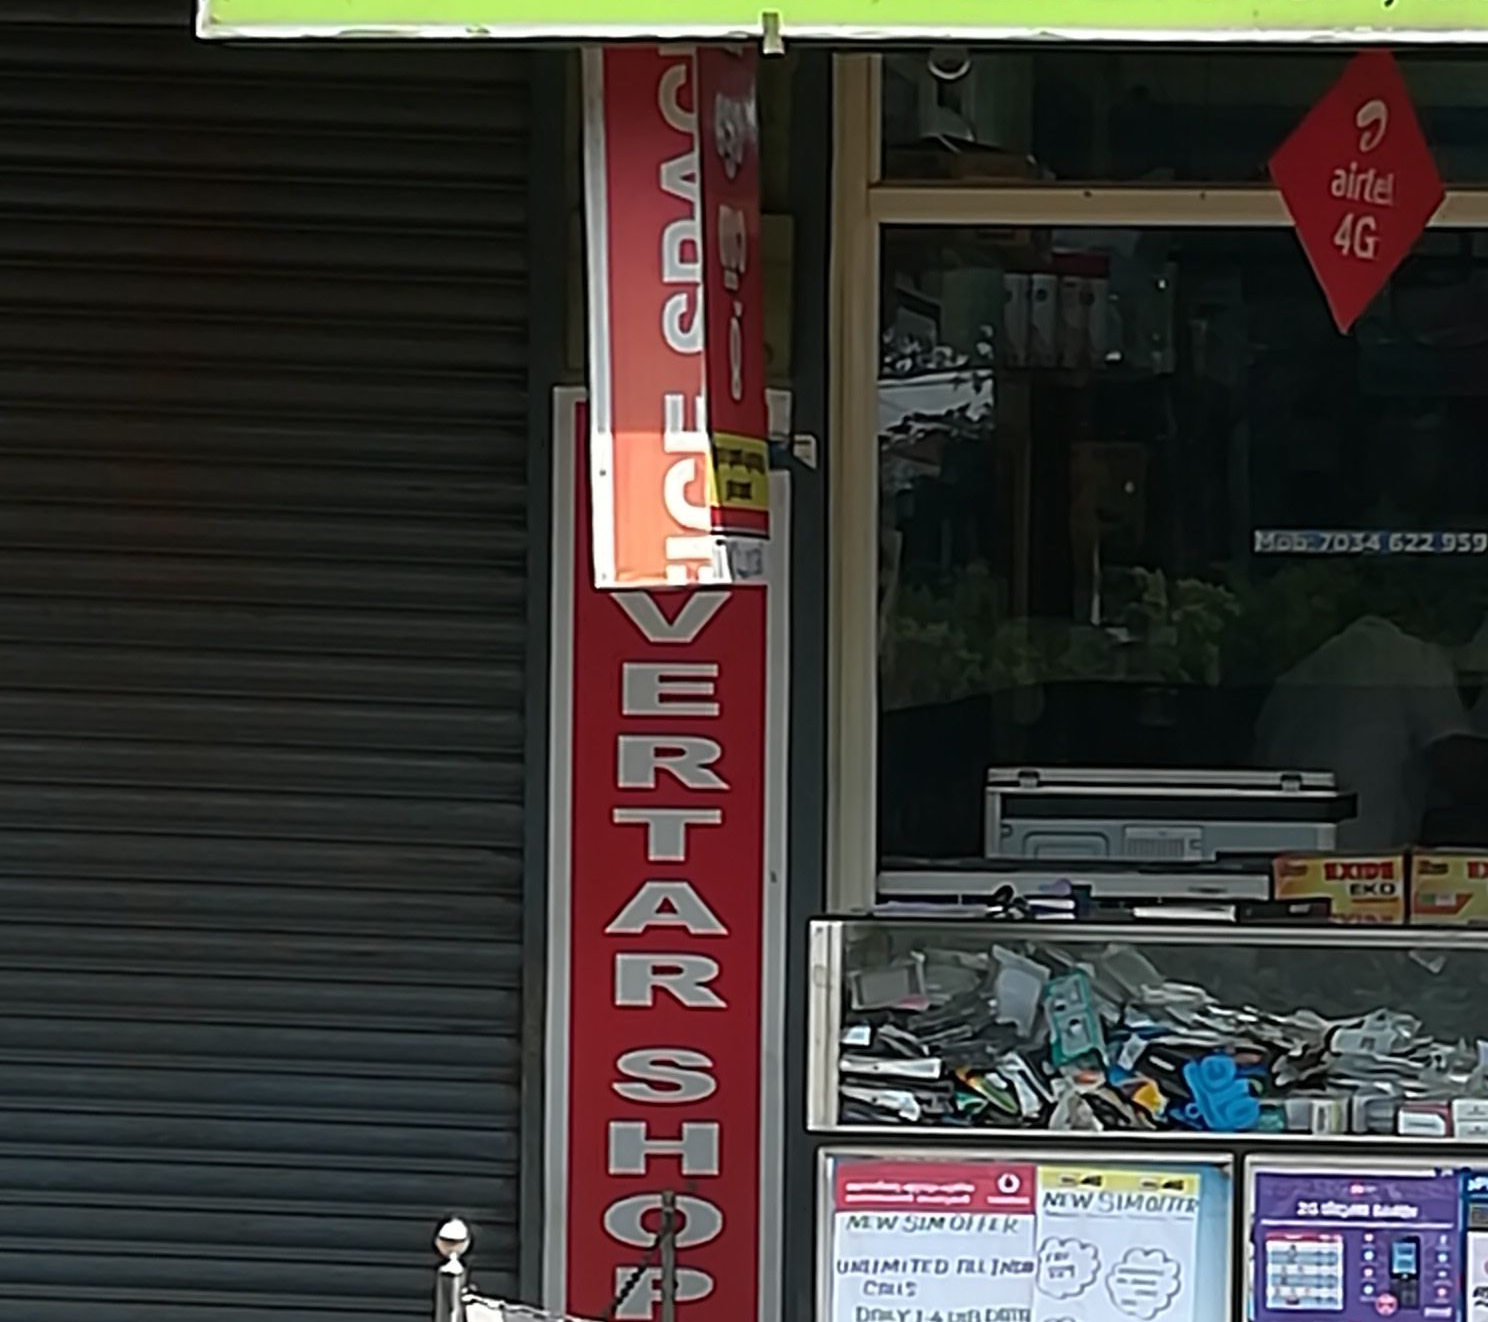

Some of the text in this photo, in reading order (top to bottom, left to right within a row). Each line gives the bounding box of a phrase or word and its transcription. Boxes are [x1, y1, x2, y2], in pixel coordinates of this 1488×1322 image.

[1330, 160, 1394, 207] airtel
[1332, 212, 1380, 261] 4G
[1319, 531, 1382, 554] 7034
[1388, 531, 1435, 554] 622
[1440, 531, 1488, 554] 959
[1323, 861, 1395, 882] EXIDE
[1348, 881, 1397, 897] EKO
[602, 1047, 724, 1322] SHOP
[1042, 1191, 1094, 1209] NEW
[846, 1214, 899, 1232] NEW
[902, 1214, 946, 1234] SIM
[836, 1257, 950, 1276] UNLIMITED
